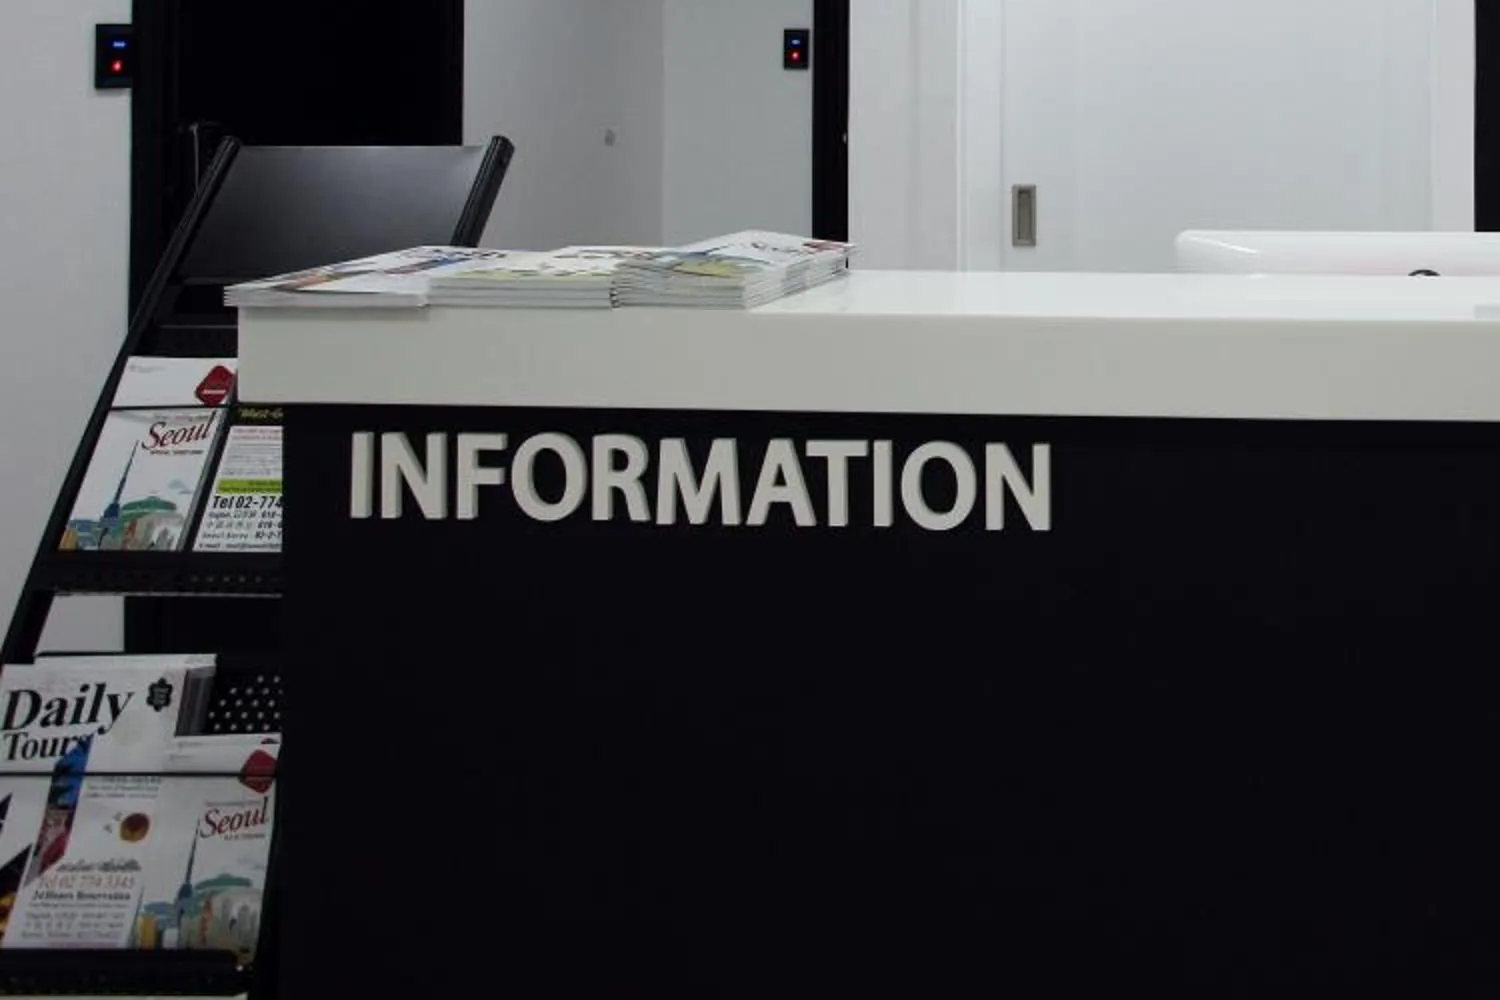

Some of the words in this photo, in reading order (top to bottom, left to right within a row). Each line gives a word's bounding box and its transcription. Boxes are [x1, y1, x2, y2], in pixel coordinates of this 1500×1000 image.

[141, 410, 217, 451] Seoul
[212, 496, 234, 509] Tel
[349, 431, 1051, 531] INFORMATION
[1, 682, 135, 735] Daily
[199, 796, 269, 839] Seoul
